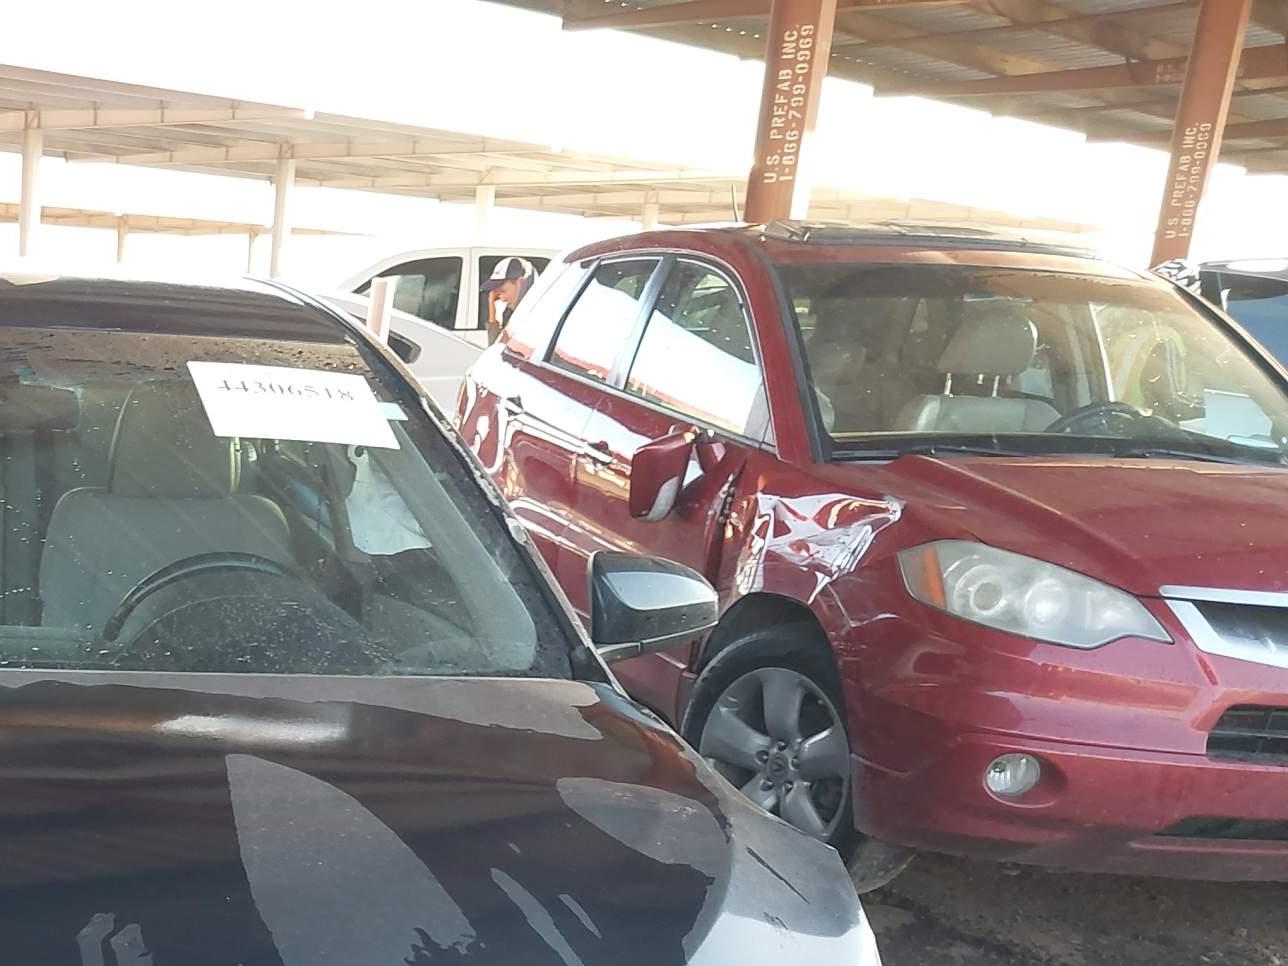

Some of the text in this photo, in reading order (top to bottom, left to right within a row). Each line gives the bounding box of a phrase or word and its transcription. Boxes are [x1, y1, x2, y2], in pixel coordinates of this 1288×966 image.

[763, 24, 799, 184] U.S. PREFAB INC.
[779, 25, 814, 181] 1-866-799-0969
